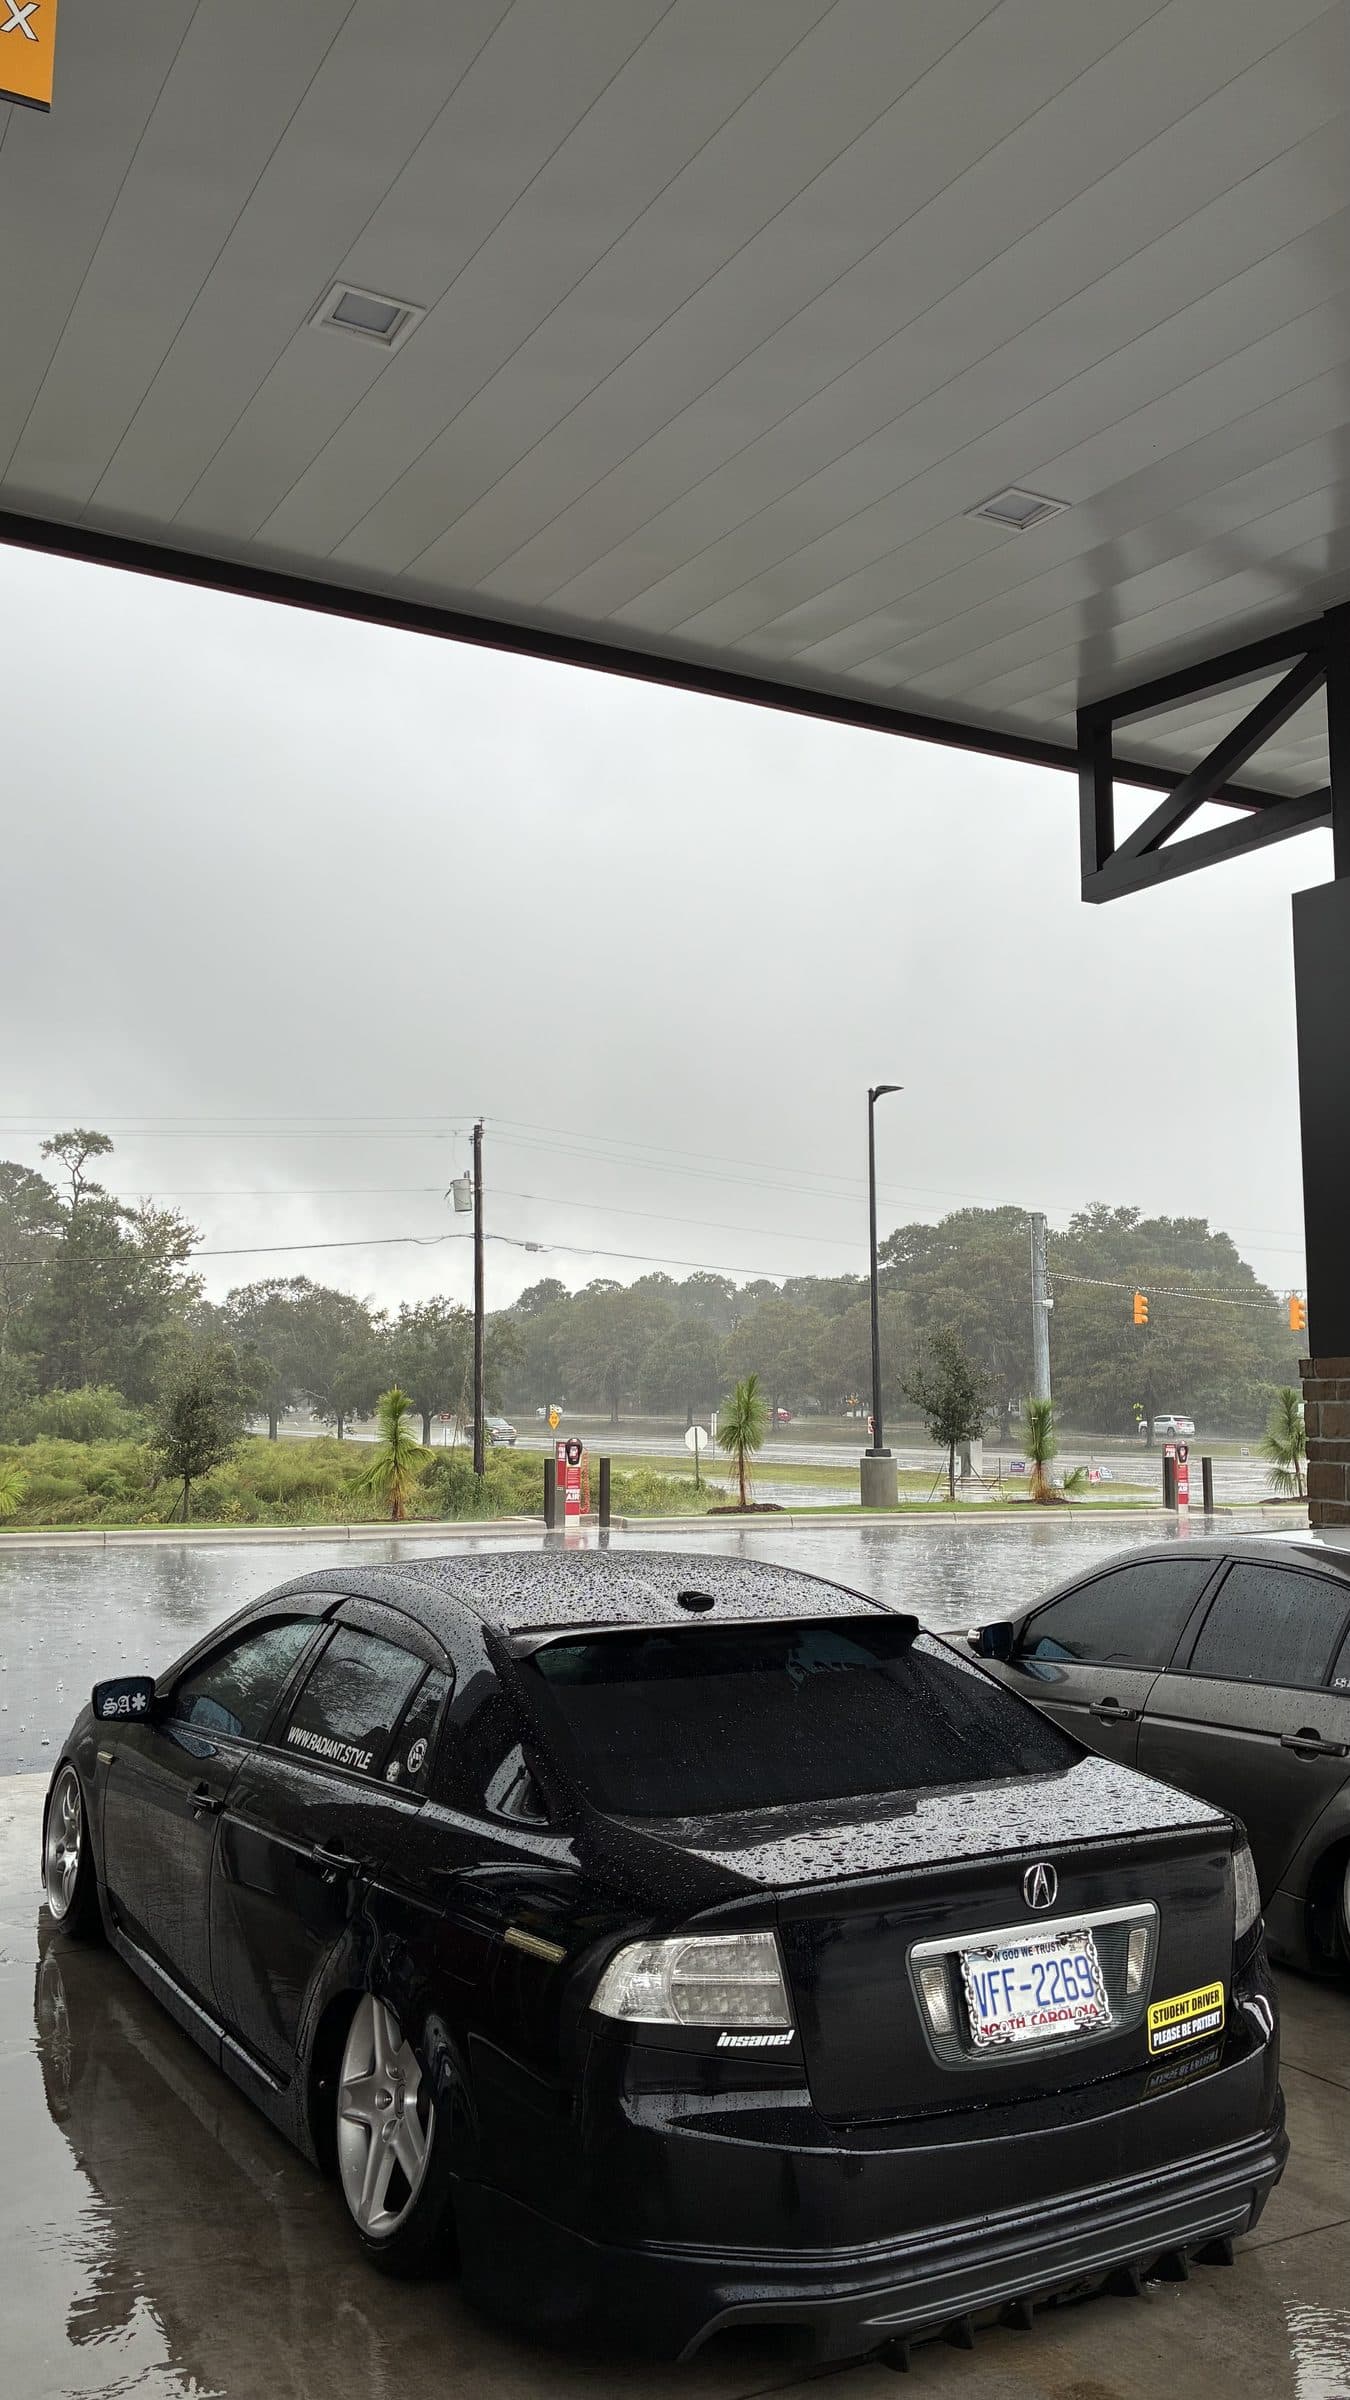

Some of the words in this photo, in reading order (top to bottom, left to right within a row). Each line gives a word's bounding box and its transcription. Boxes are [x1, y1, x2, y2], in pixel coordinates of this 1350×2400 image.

[287, 1726, 374, 1770] WWW.RADIANT.STYLE
[1002, 1949, 1019, 1961] GOD
[1021, 1946, 1033, 1958] WE
[1035, 1941, 1061, 1955] TRUST
[973, 1955, 1095, 2018] VFF-2269
[1153, 2000, 1190, 2024] STUDENT
[1191, 1990, 1220, 2011] DRIVER
[980, 2017, 1026, 2035] NOTH
[1153, 2025, 1181, 2047] PLEASE
[1181, 2022, 1192, 2037] BE
[1192, 2010, 1221, 2033] PATIENT
